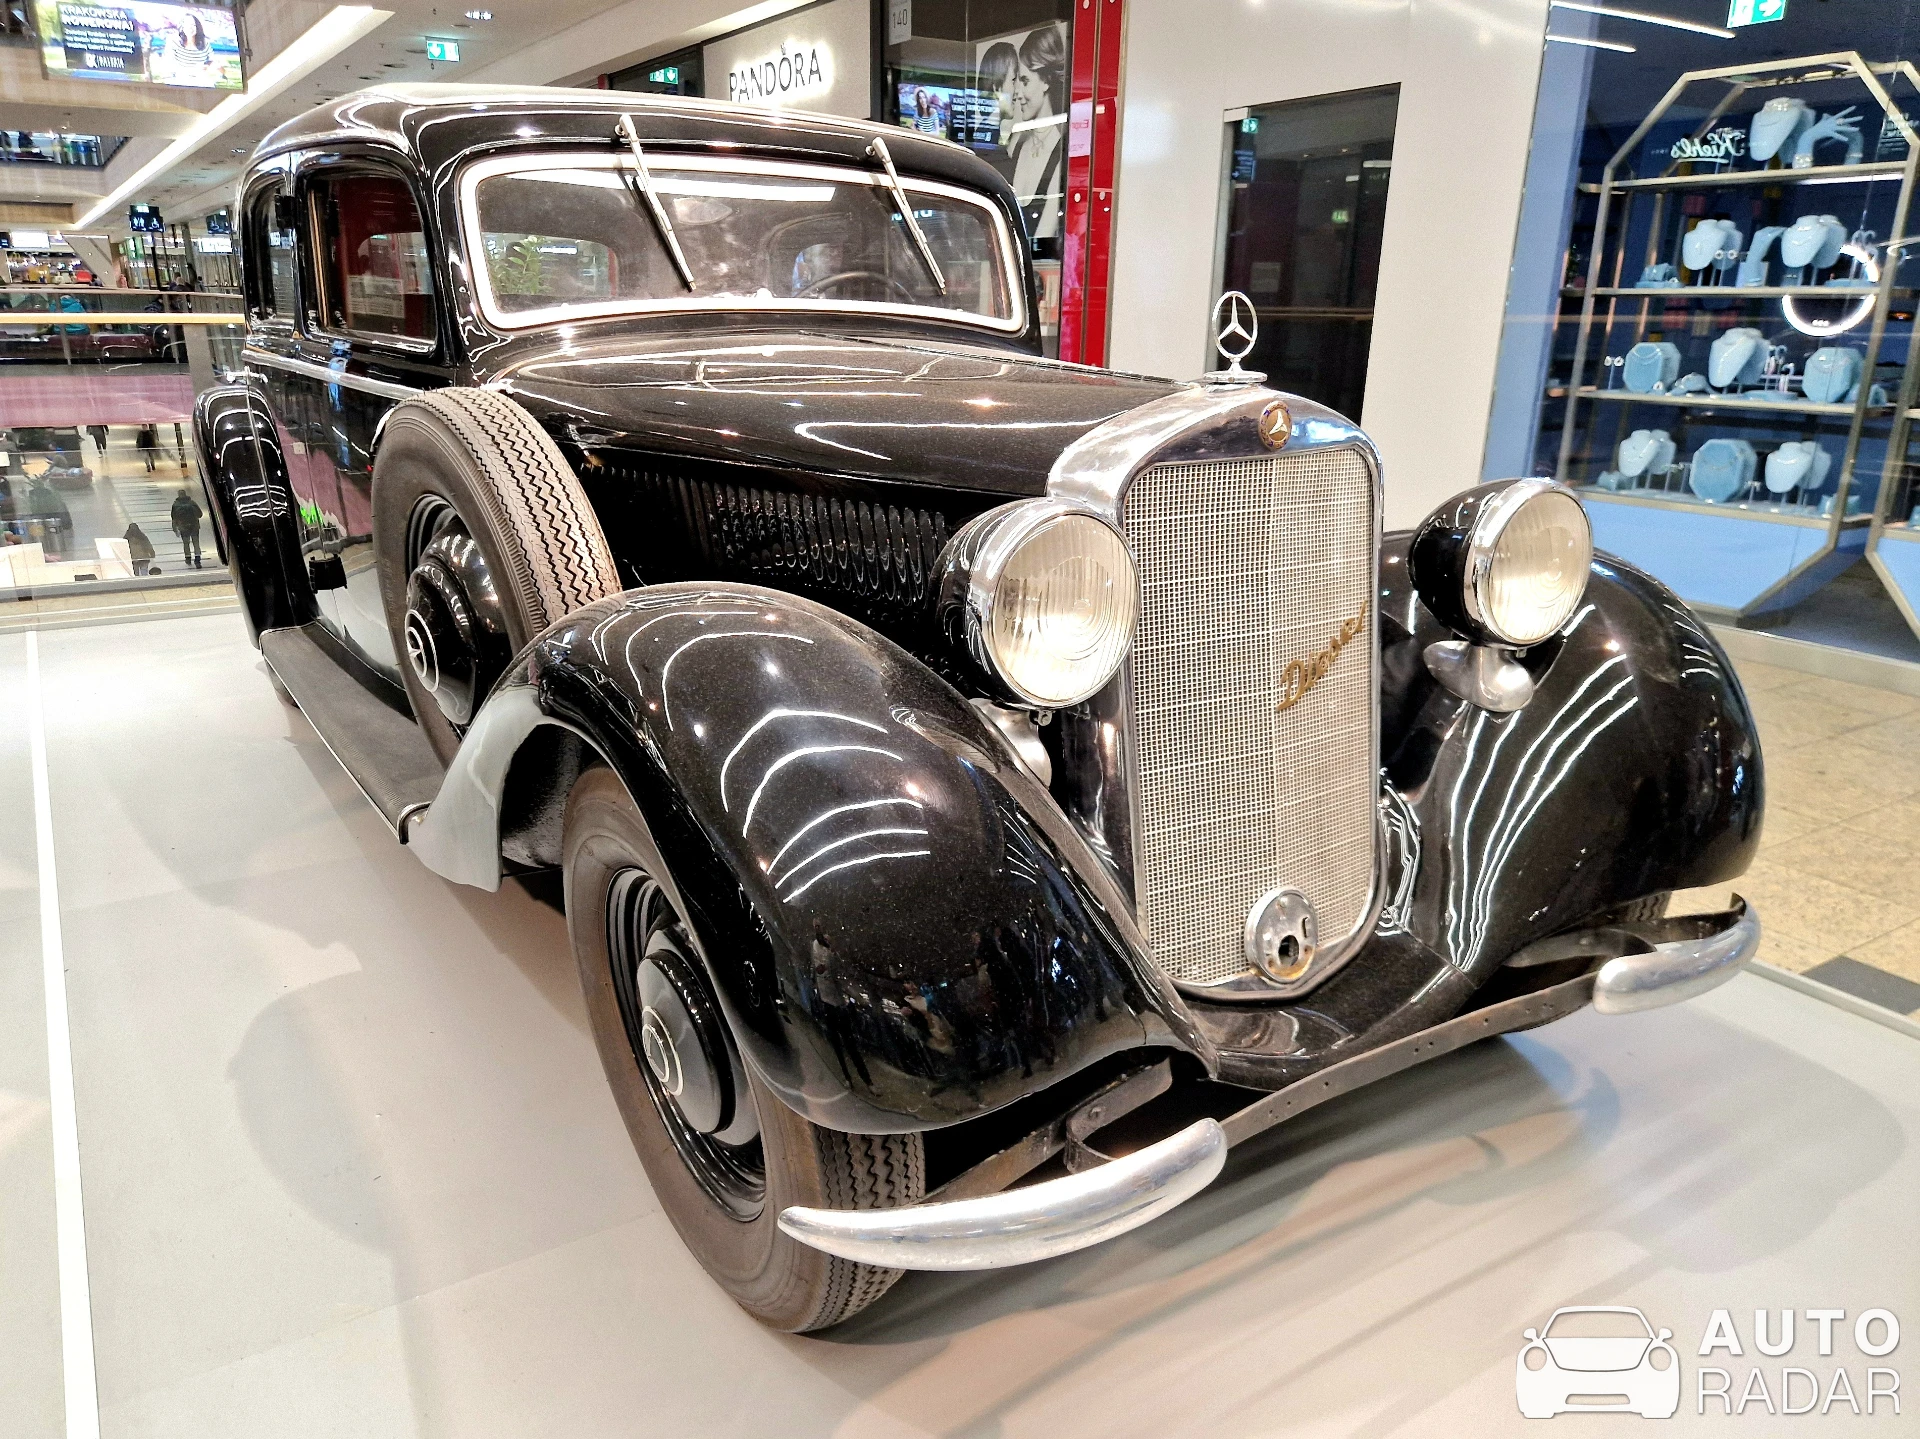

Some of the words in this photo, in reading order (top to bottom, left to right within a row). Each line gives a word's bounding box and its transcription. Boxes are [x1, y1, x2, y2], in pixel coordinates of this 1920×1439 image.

[892, 8, 908, 29] 140
[729, 48, 822, 103] PANDORA
[1276, 600, 1367, 712] Diesel
